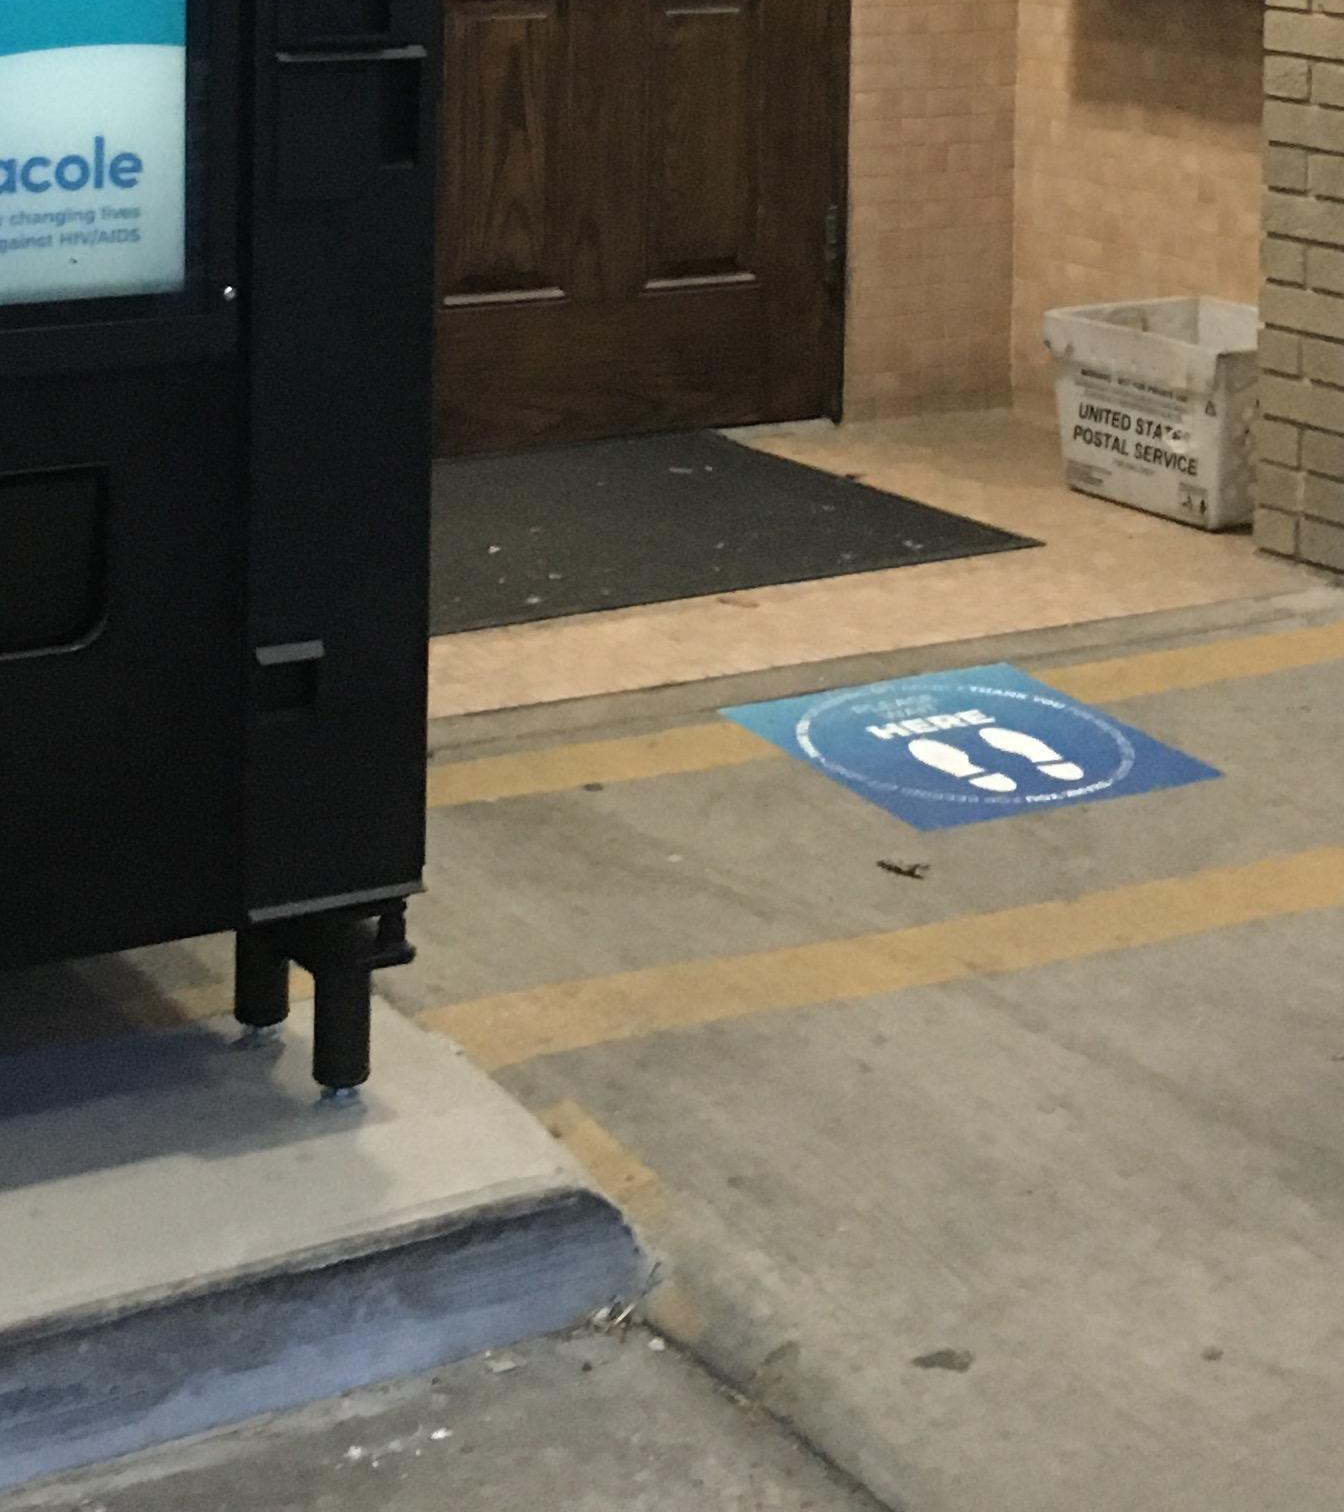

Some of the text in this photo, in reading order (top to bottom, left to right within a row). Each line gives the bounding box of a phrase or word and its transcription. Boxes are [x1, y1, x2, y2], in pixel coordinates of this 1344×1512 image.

[9, 208, 96, 227] changing
[101, 205, 142, 221] lives
[59, 228, 142, 247] HIV/AIDS
[1078, 402, 1132, 432] UNITED
[1135, 417, 1190, 441] STATE
[1073, 425, 1129, 456] POSTAL
[1134, 442, 1199, 476] SERVICE
[865, 708, 997, 740] HERE
